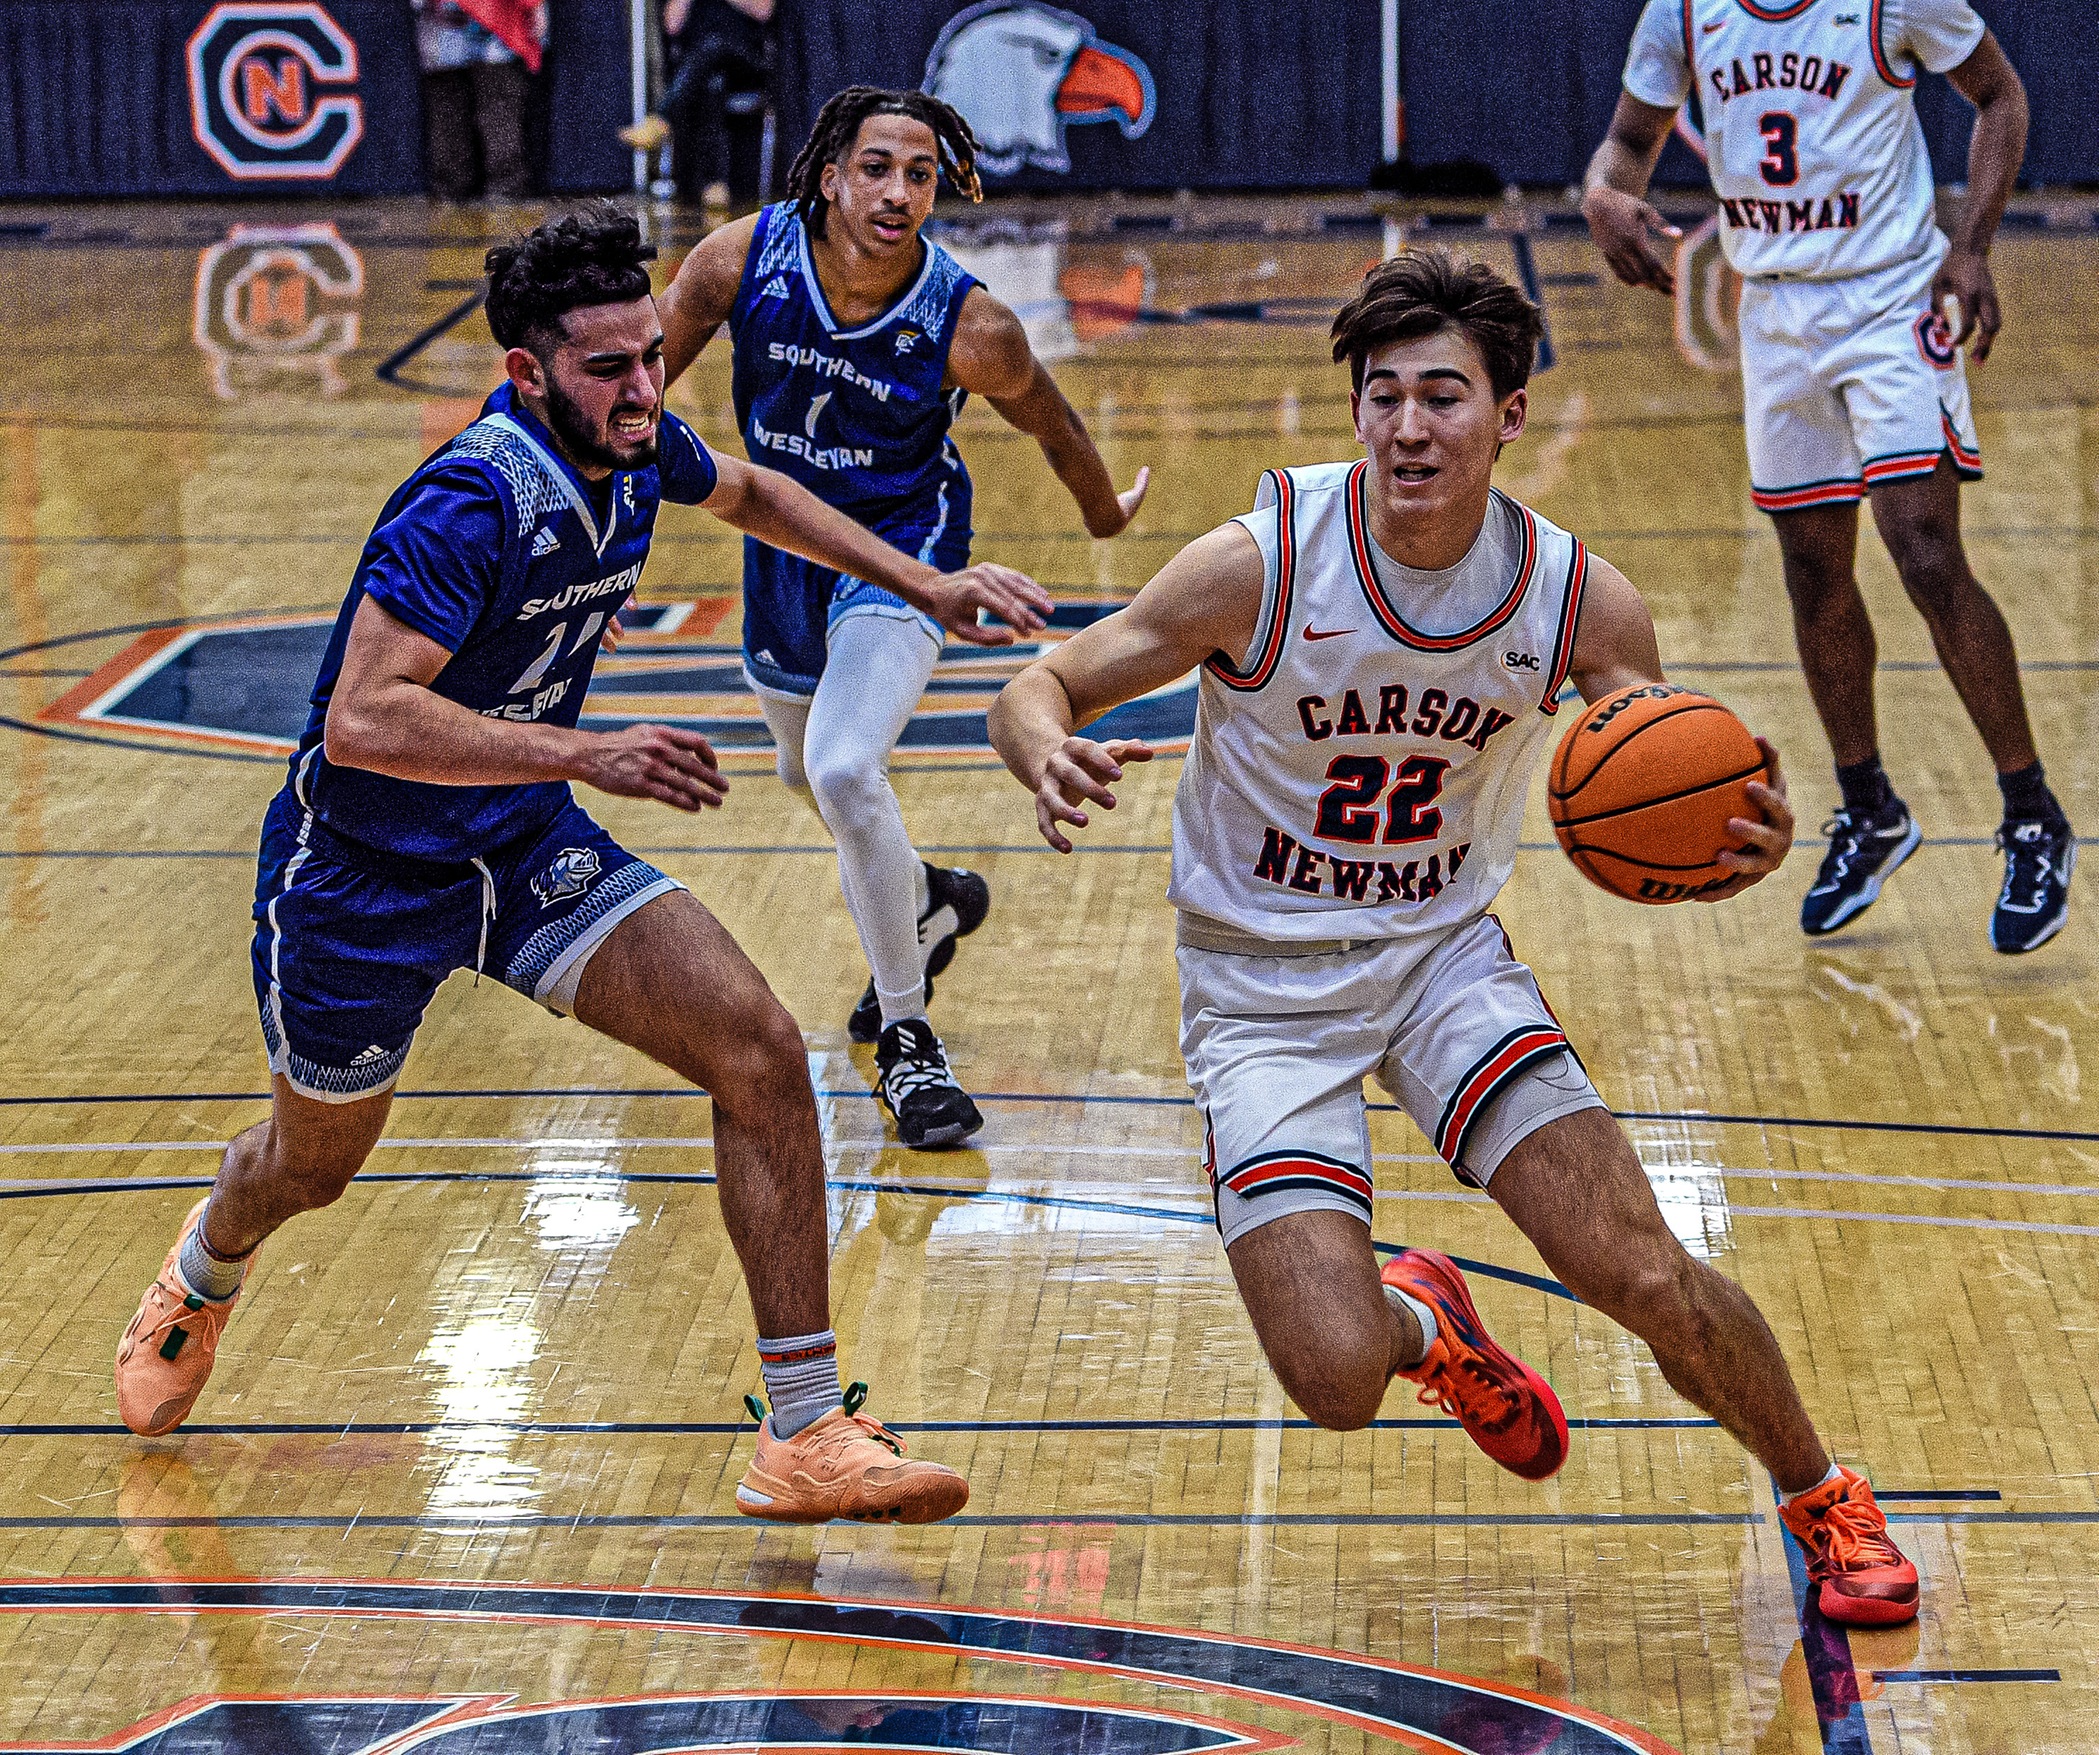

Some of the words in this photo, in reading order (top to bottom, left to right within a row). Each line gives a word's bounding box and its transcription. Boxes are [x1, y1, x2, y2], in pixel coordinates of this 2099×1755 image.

[1711, 52, 1852, 102] CARSON
[1758, 109, 1800, 188] 3
[804, 391, 833, 439] 1
[754, 418, 873, 470] WESLEYAN
[516, 560, 641, 621] SUTHERN
[1505, 650, 1540, 671] SAC
[1312, 754, 1452, 845] 22
[350, 1050, 390, 1066] adidas
